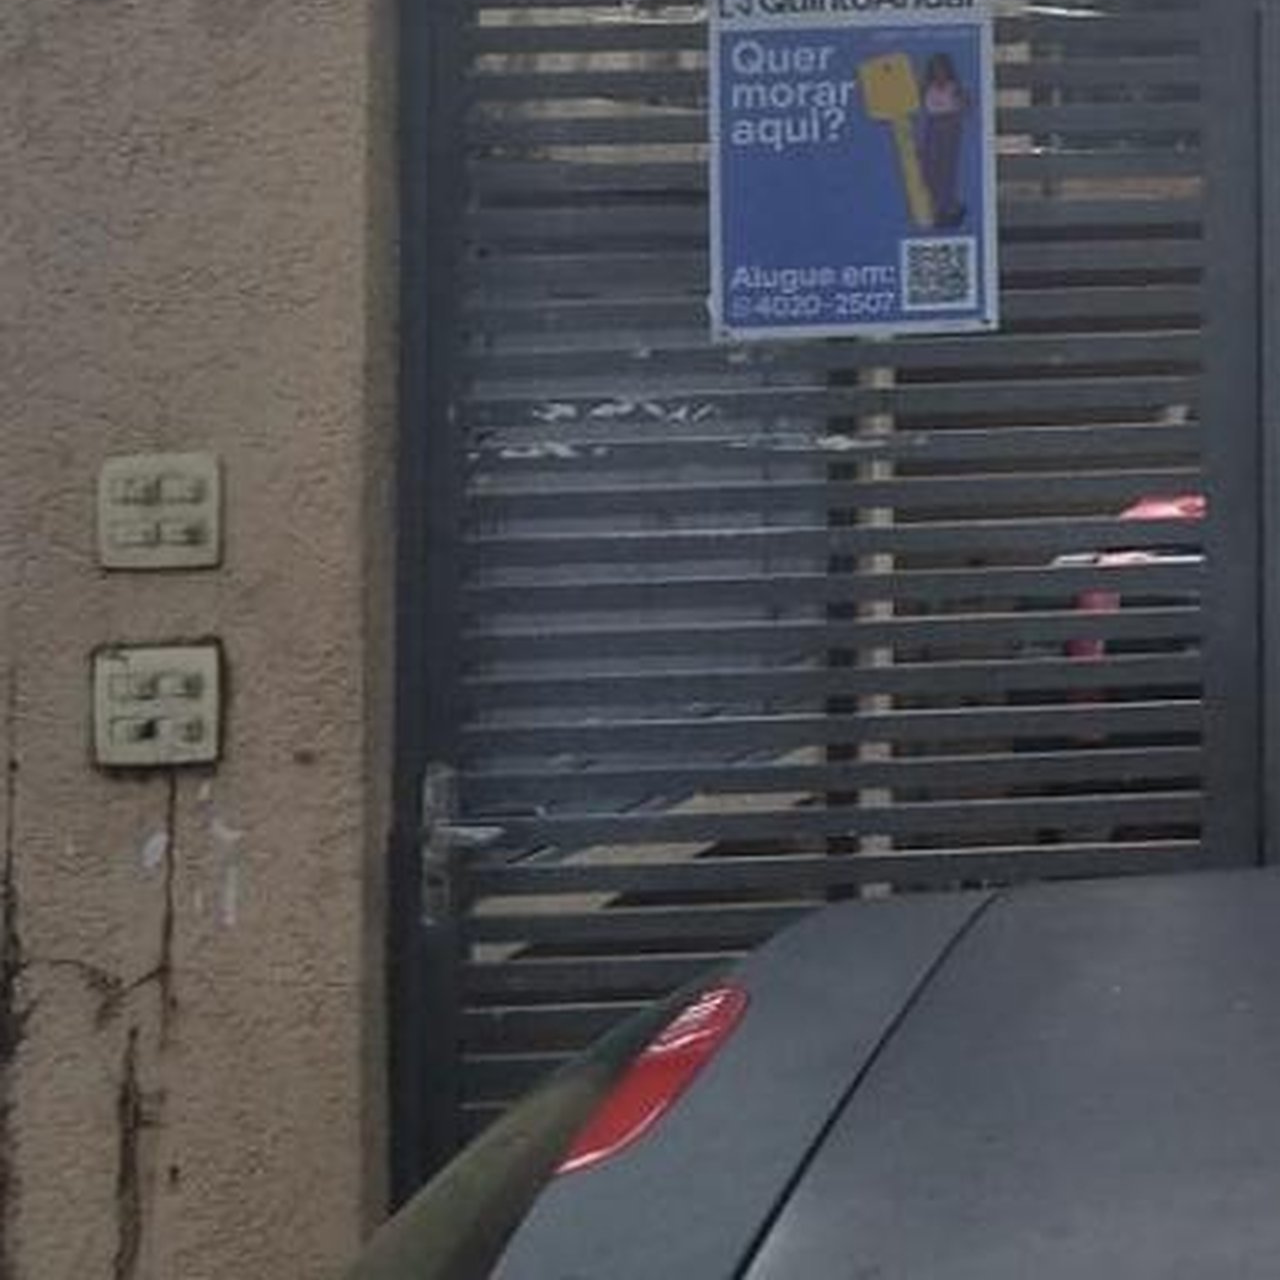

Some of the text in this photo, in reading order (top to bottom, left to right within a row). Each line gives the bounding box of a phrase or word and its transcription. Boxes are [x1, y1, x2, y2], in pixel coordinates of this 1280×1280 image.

[731, 40, 834, 75] Quer
[731, 80, 855, 109] morar
[731, 109, 844, 151] aqui?
[731, 266, 836, 294] Alugue
